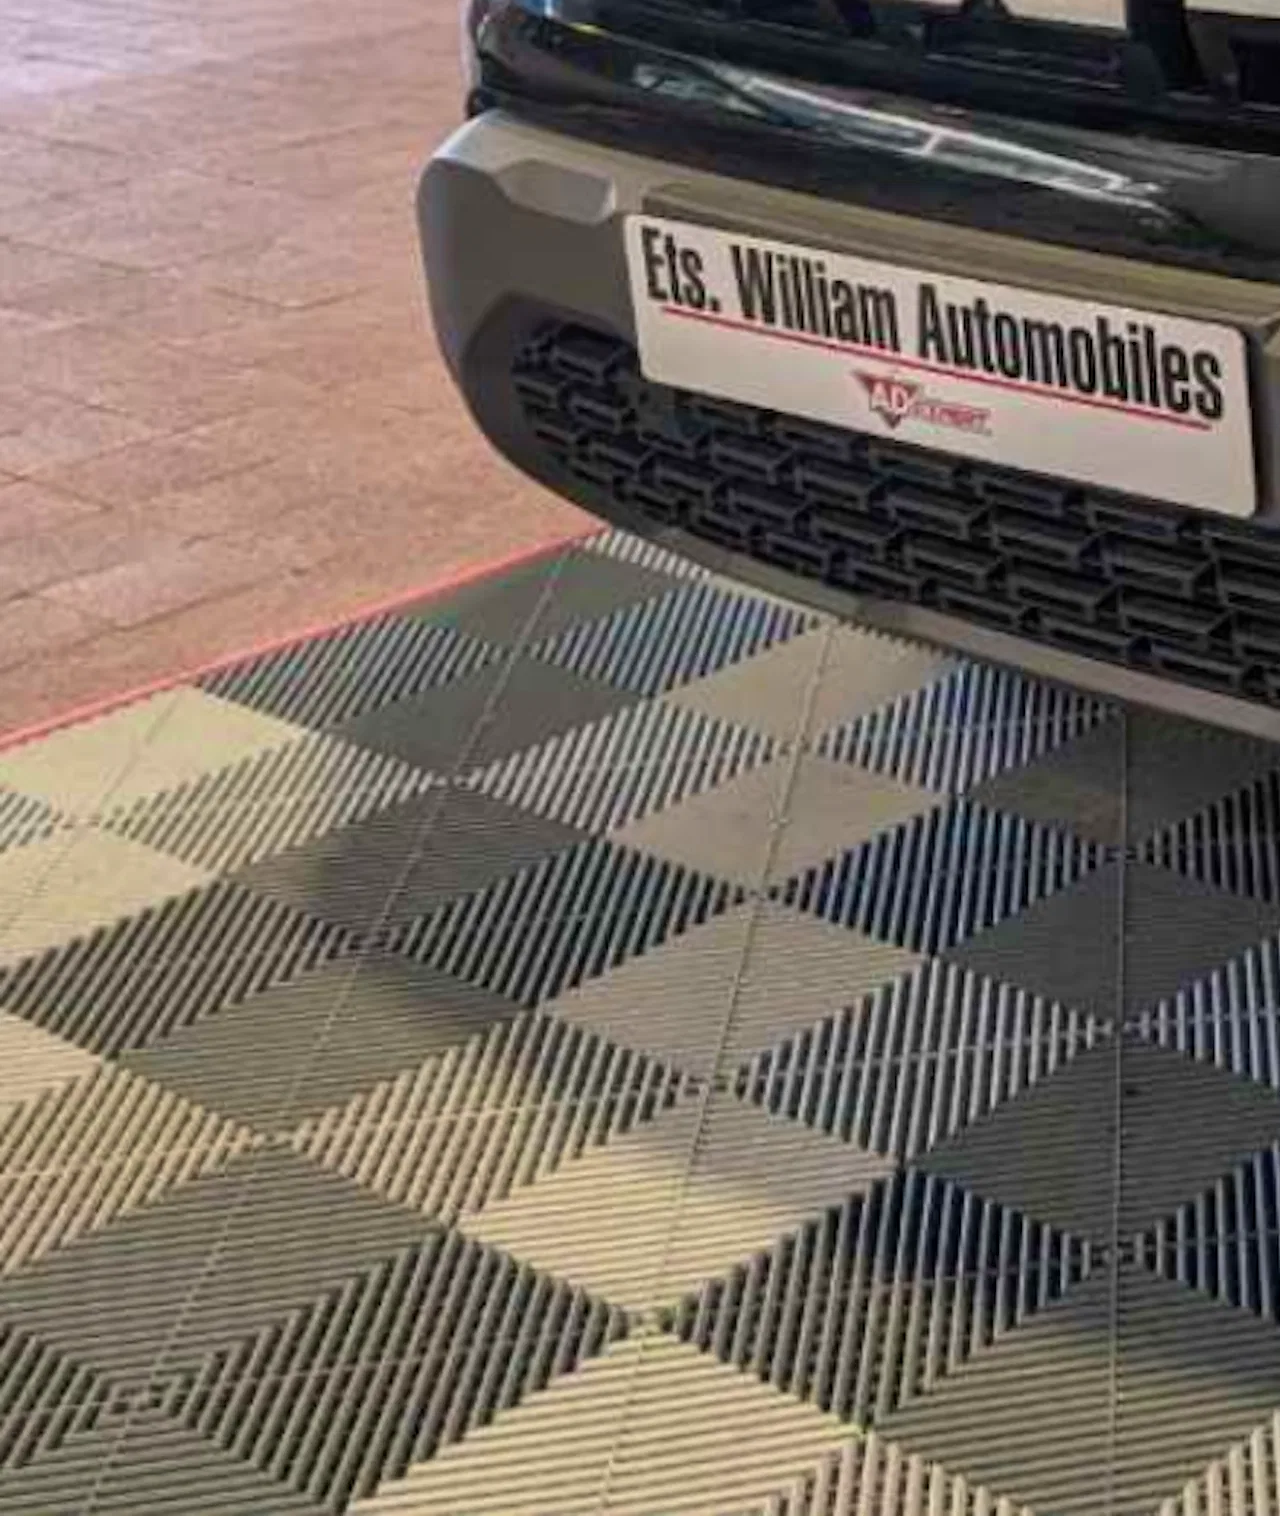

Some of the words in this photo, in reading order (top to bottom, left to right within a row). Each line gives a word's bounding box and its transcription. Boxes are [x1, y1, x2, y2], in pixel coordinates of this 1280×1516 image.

[640, 226, 722, 313] Ets.
[730, 245, 900, 354] William
[917, 283, 1224, 421] Automobiles
